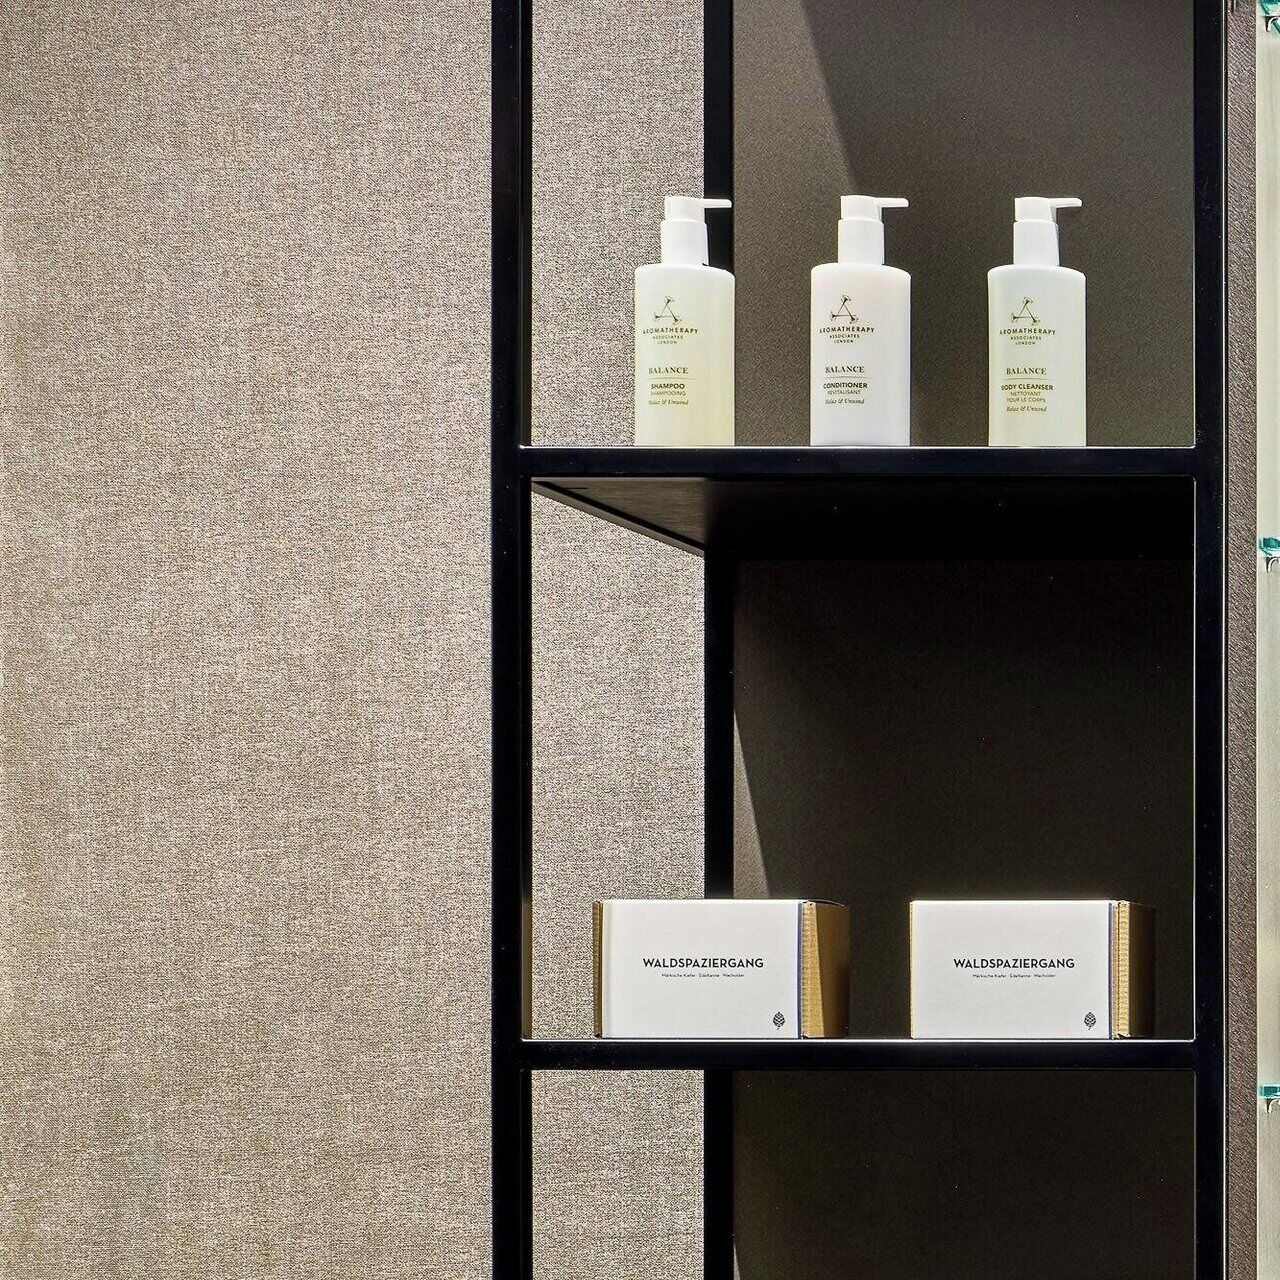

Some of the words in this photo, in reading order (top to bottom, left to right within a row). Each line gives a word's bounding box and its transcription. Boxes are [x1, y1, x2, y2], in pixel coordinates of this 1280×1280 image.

[648, 366, 689, 374] BALANCE
[825, 365, 865, 373] BALANCE
[1006, 367, 1047, 375] BALANCE
[1018, 383, 1054, 391] CLEANSER
[642, 957, 764, 968] WALDSPAZIERGANG
[953, 958, 1075, 969] WALDSPAZIERGANG
